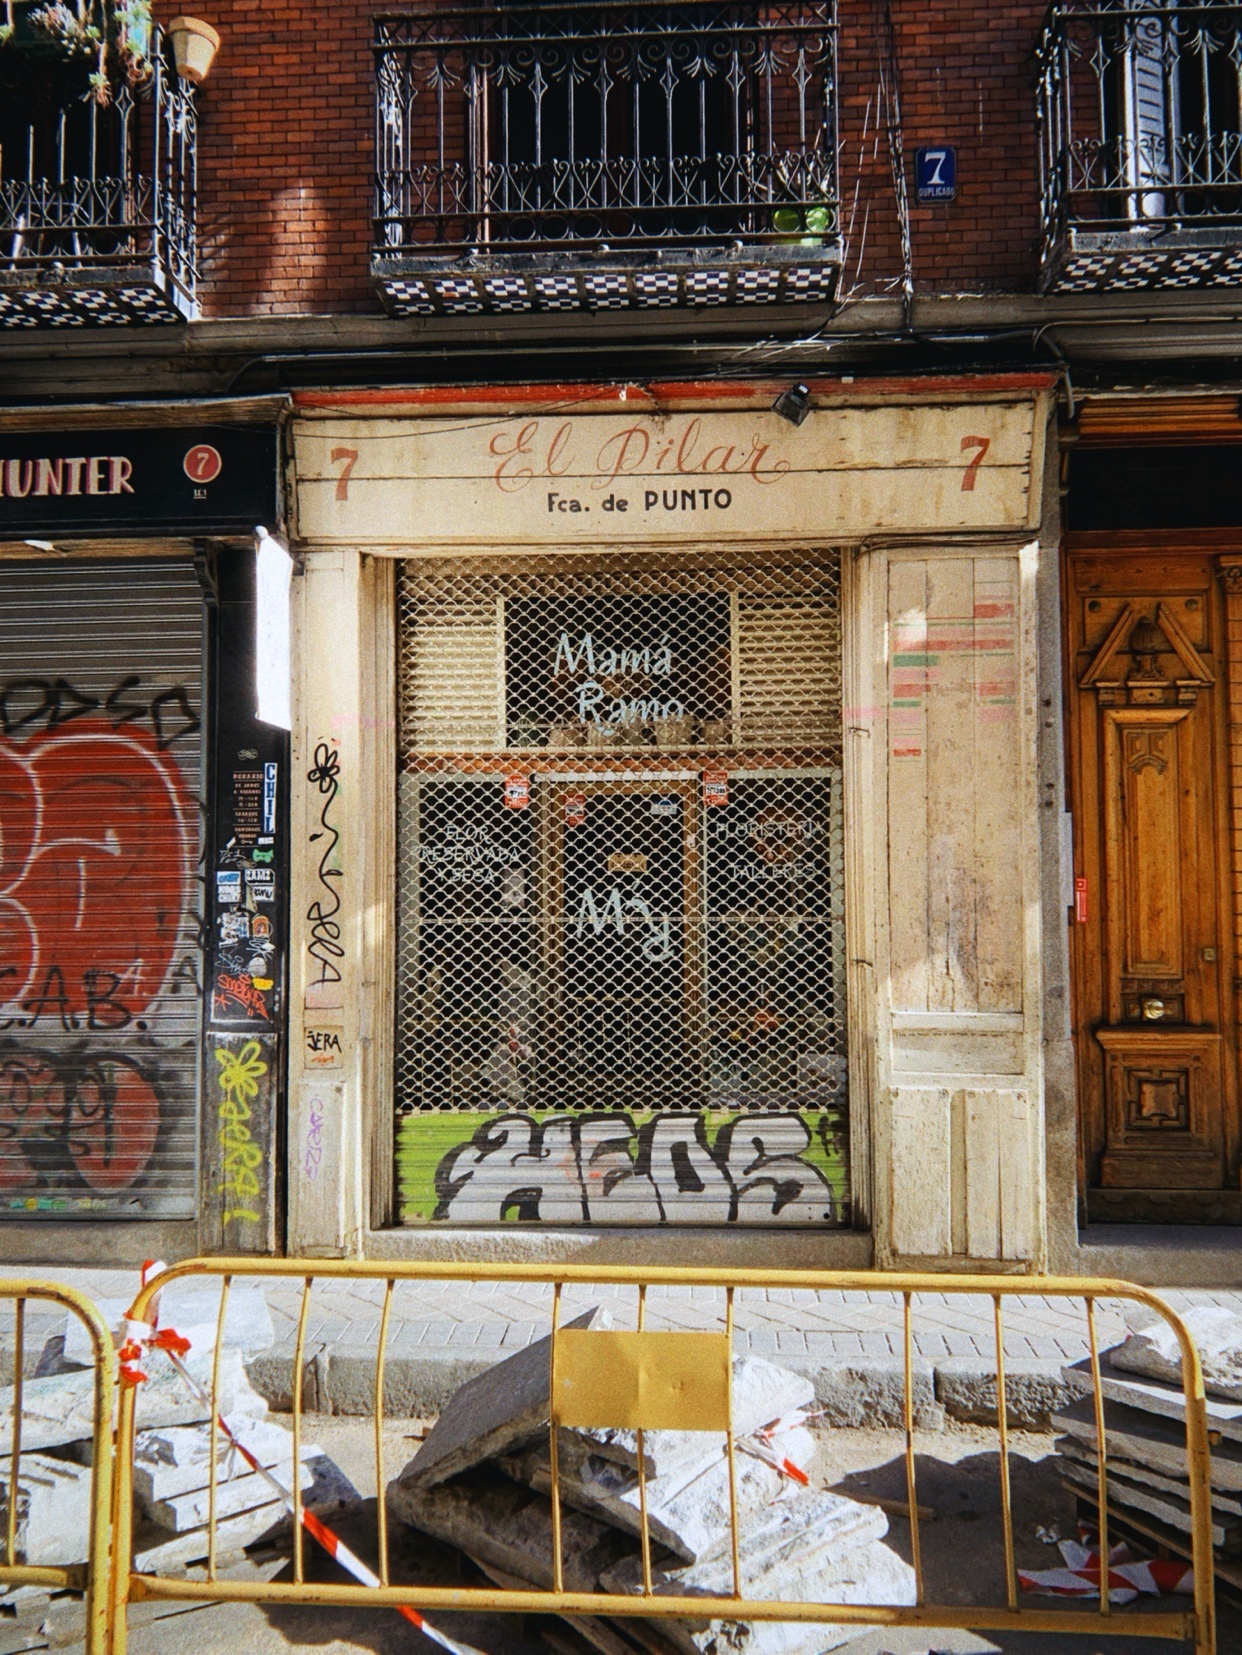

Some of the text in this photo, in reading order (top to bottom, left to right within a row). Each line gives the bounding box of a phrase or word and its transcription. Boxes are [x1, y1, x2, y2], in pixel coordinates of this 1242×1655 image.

[925, 151, 946, 185] 7
[918, 188, 955, 197] DUPLICADO
[196, 452, 209, 476] 7
[330, 446, 358, 501] 7
[489, 417, 791, 493] El Pilar
[960, 435, 991, 492] 7
[0, 456, 135, 498] UNTER
[547, 488, 732, 513] Fca. de PUNTO
[553, 632, 672, 676] Mamá
